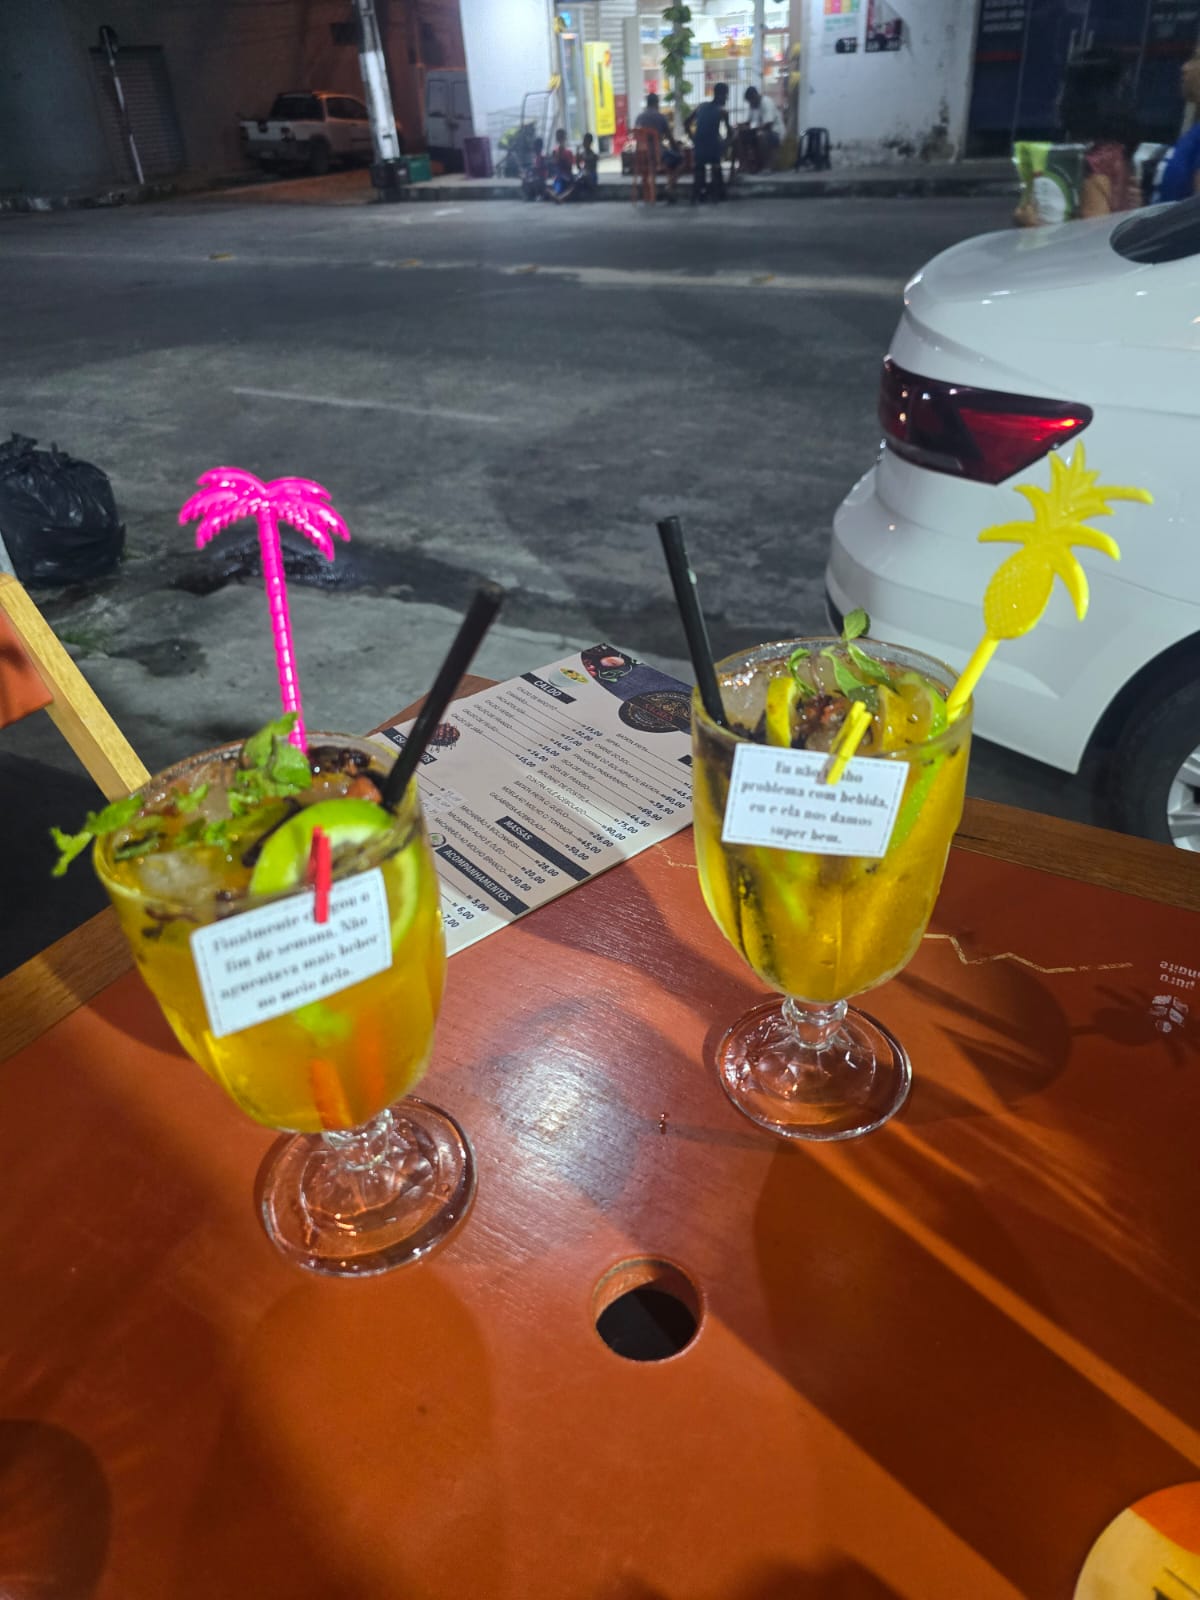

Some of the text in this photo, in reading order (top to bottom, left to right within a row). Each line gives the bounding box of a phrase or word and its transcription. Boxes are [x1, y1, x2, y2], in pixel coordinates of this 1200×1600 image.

[532, 680, 564, 696] CALDO
[574, 730, 594, 741] 22,00
[774, 760, 792, 775] Eu
[740, 779, 806, 800] problema
[807, 789, 838, 802] com
[748, 802, 874, 827] eu e ela nos damos
[502, 820, 534, 840] MASSAS
[616, 820, 639, 834] 75,00
[768, 825, 808, 842] super
[591, 833, 615, 847] 26,00
[440, 848, 515, 902] ACOMPANHAMENTOS
[523, 869, 547, 885] 20,00
[509, 876, 533, 892] 30,00
[454, 906, 475, 920] 6,00
[469, 898, 490, 912] 5,00
